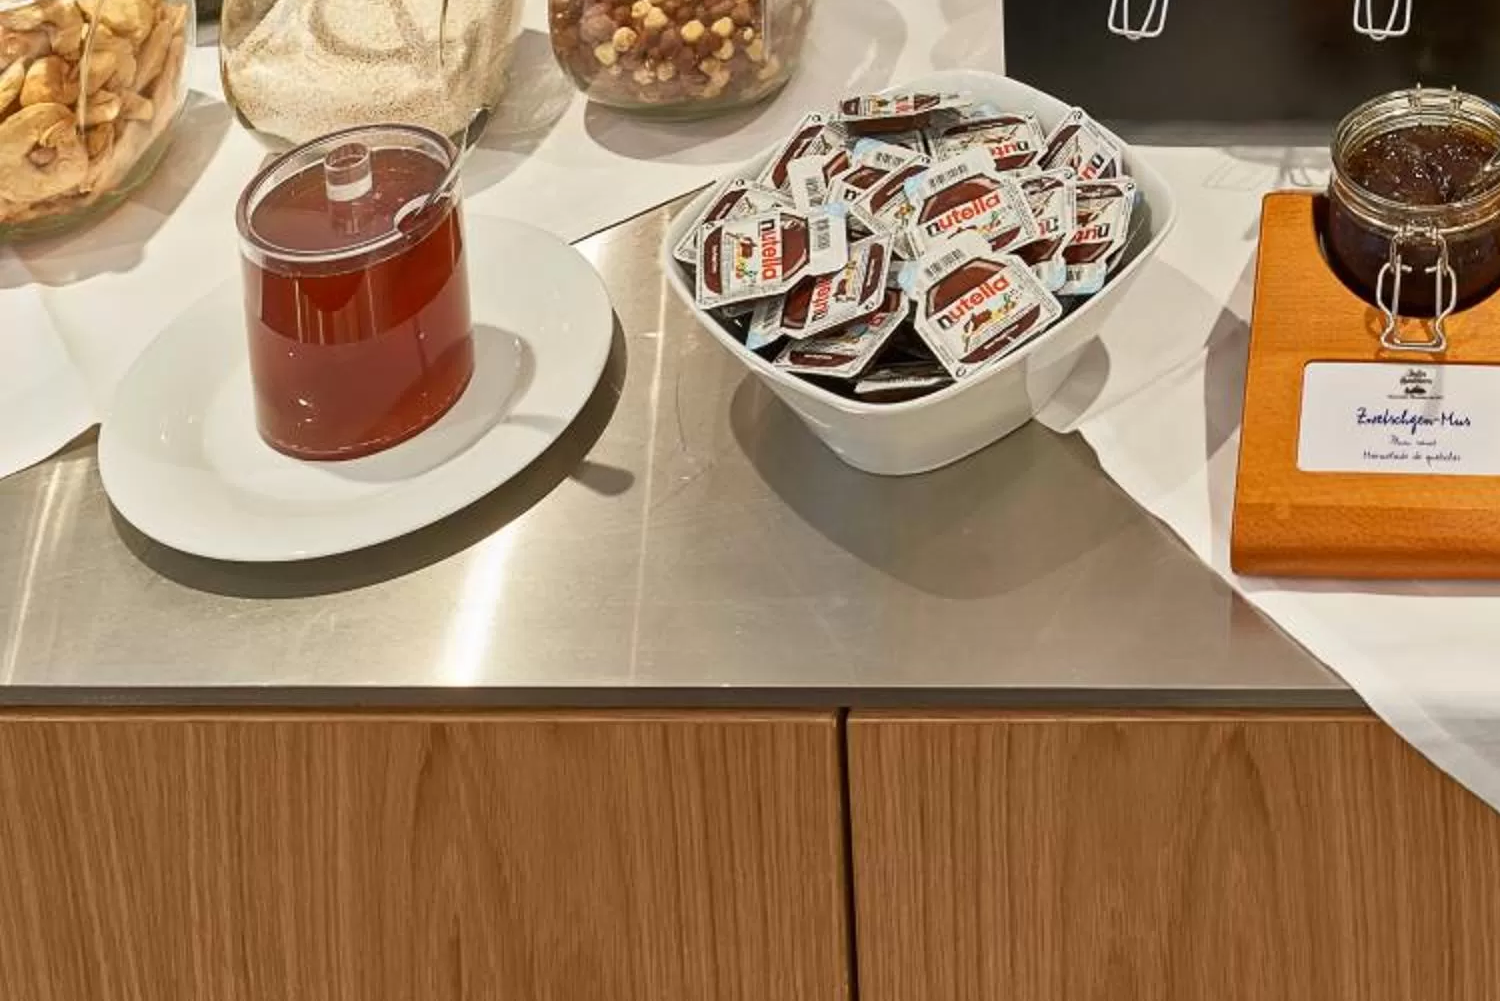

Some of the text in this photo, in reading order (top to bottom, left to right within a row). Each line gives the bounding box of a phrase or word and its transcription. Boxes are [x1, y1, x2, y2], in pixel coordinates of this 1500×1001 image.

[926, 193, 1001, 237] nutella
[758, 218, 782, 281] nutella
[936, 275, 1010, 330] nutella
